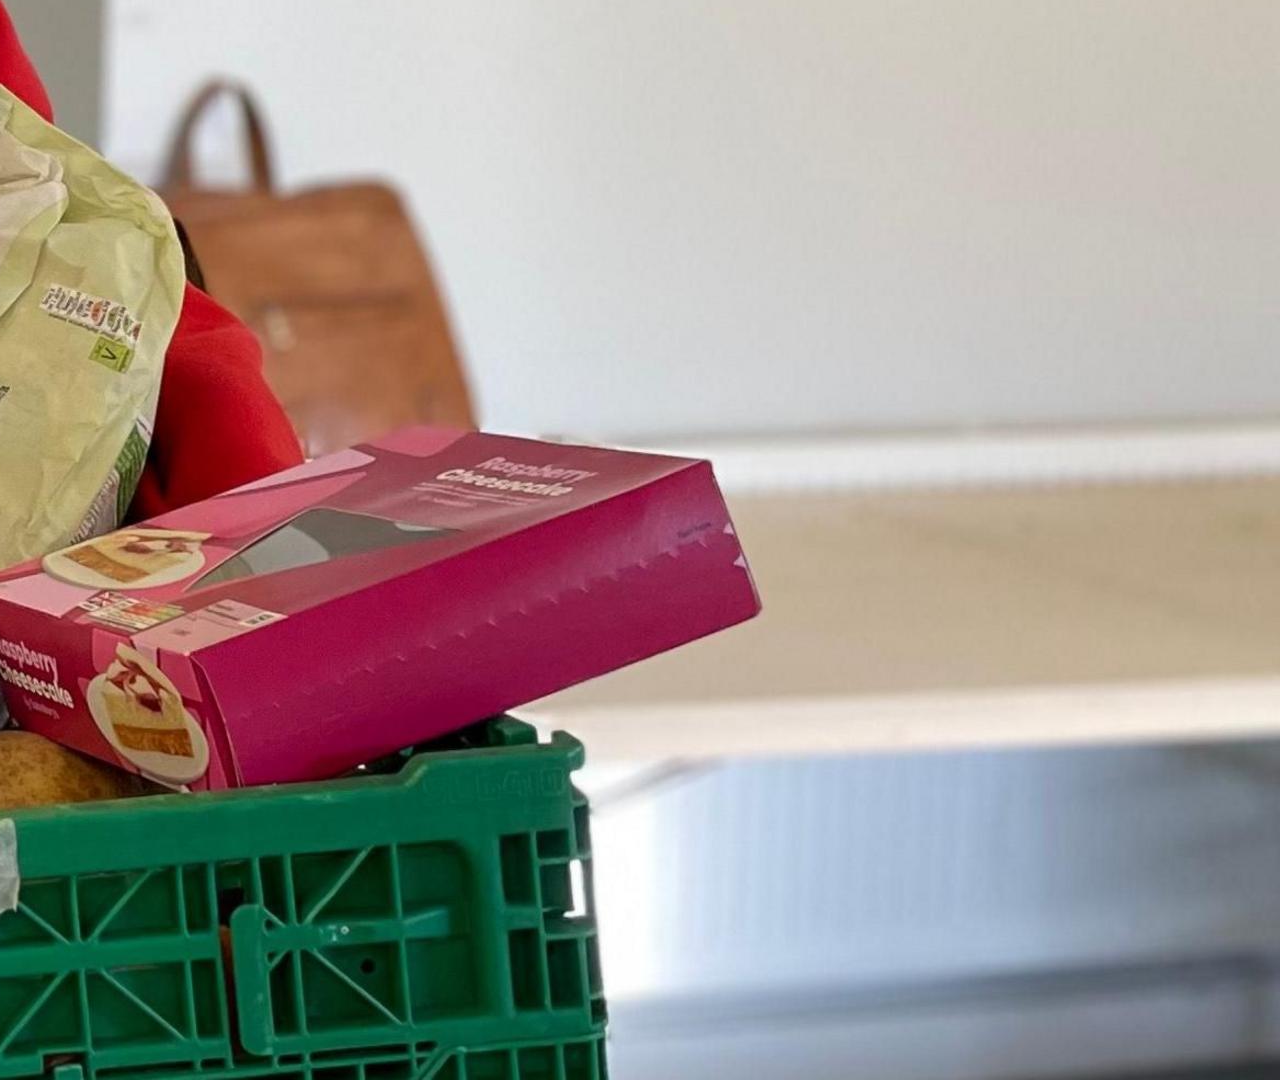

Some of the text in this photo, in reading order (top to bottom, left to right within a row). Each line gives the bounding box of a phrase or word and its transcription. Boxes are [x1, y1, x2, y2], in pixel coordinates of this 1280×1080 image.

[100, 347, 117, 360] V
[436, 469, 573, 497] Cheesecake
[474, 456, 600, 484] Raspberry
